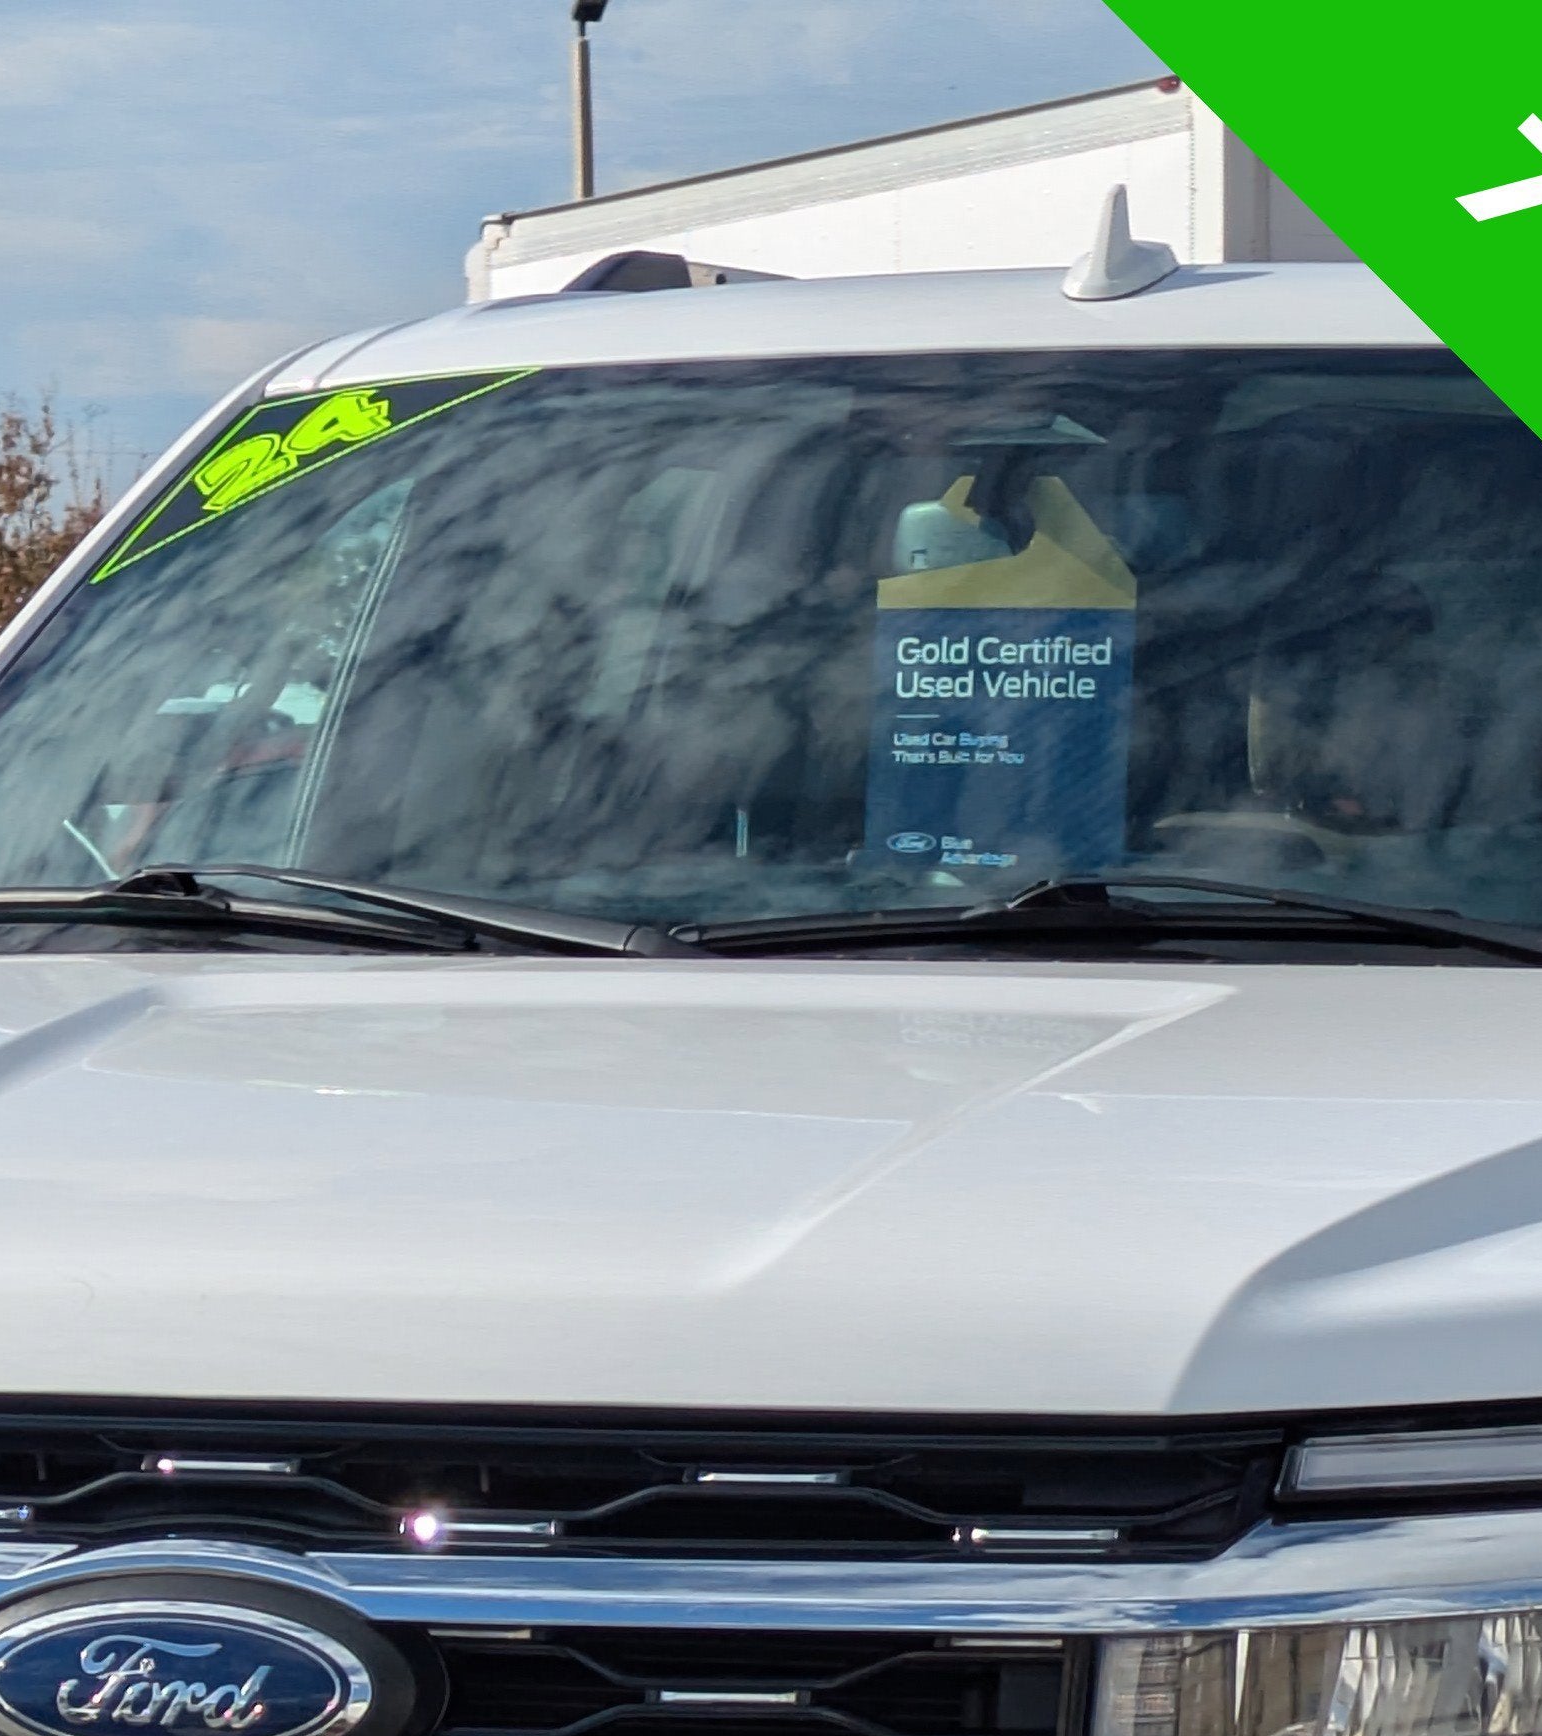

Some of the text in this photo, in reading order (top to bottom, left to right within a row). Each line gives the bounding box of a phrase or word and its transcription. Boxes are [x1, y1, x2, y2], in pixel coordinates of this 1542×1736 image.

[194, 388, 394, 512] 24
[896, 636, 1112, 665] Gold Certified
[896, 670, 1096, 698] Used Vehicle
[57, 1634, 272, 1730] Ford
